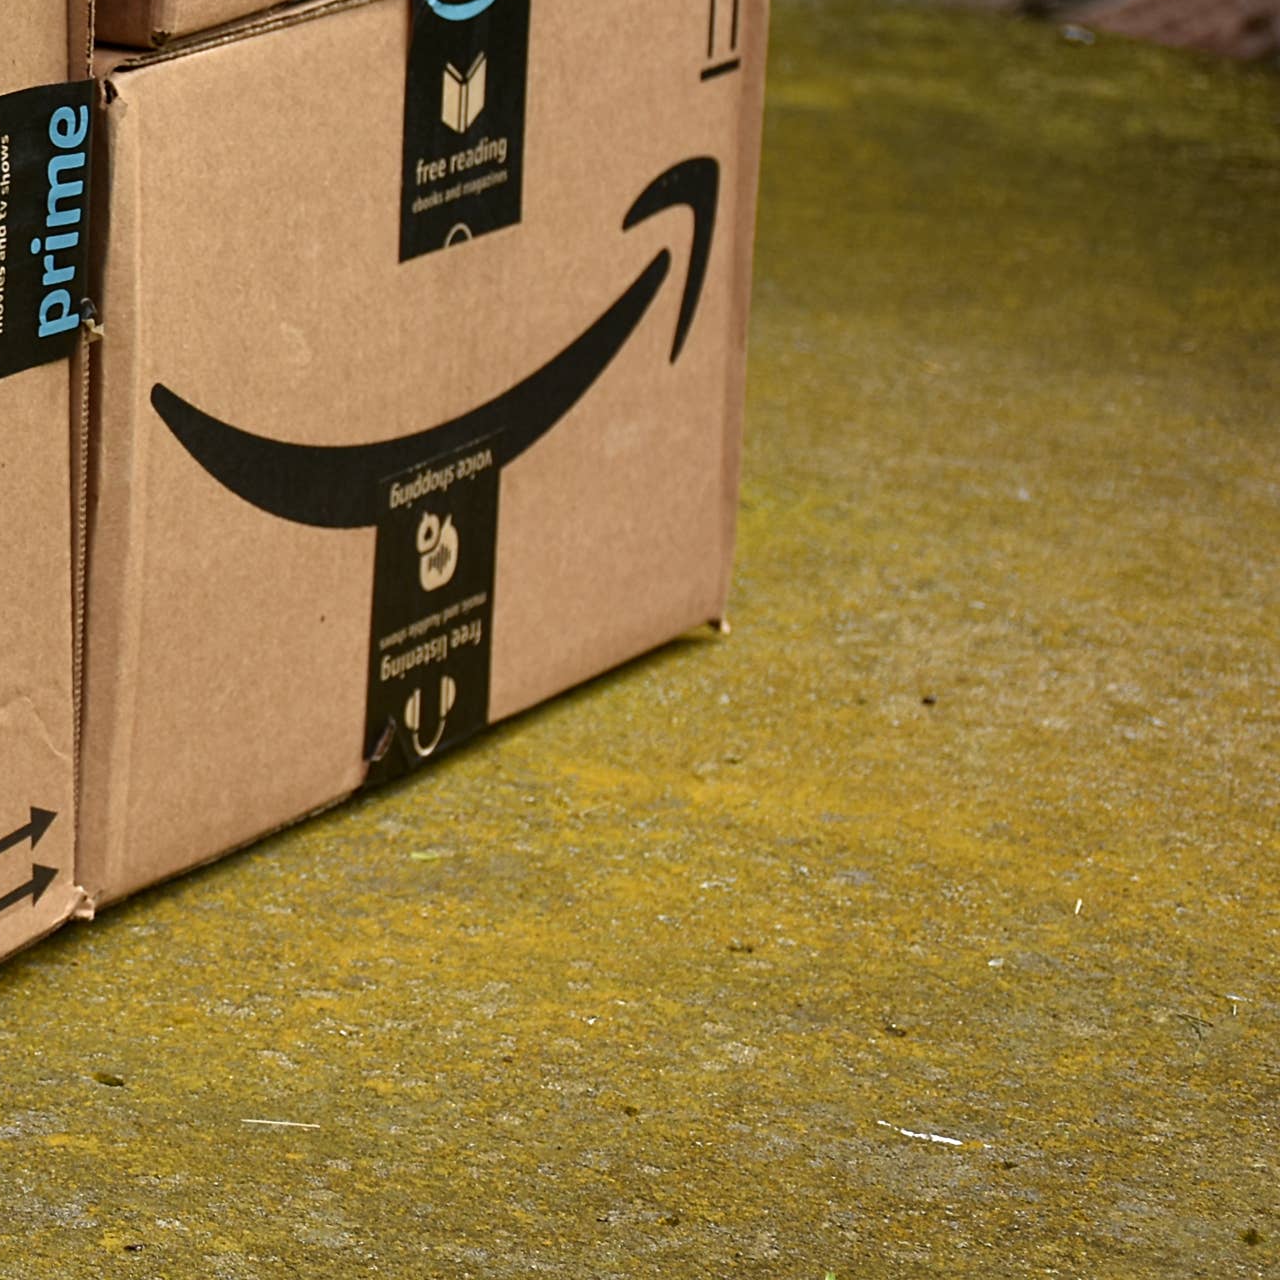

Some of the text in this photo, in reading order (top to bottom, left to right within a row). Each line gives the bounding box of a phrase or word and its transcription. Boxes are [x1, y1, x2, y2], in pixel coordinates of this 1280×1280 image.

[0, 134, 11, 193] shows
[416, 136, 508, 186] free reading
[30, 104, 90, 338] prime
[389, 448, 493, 509] voice shopping
[381, 618, 483, 682] free listening
